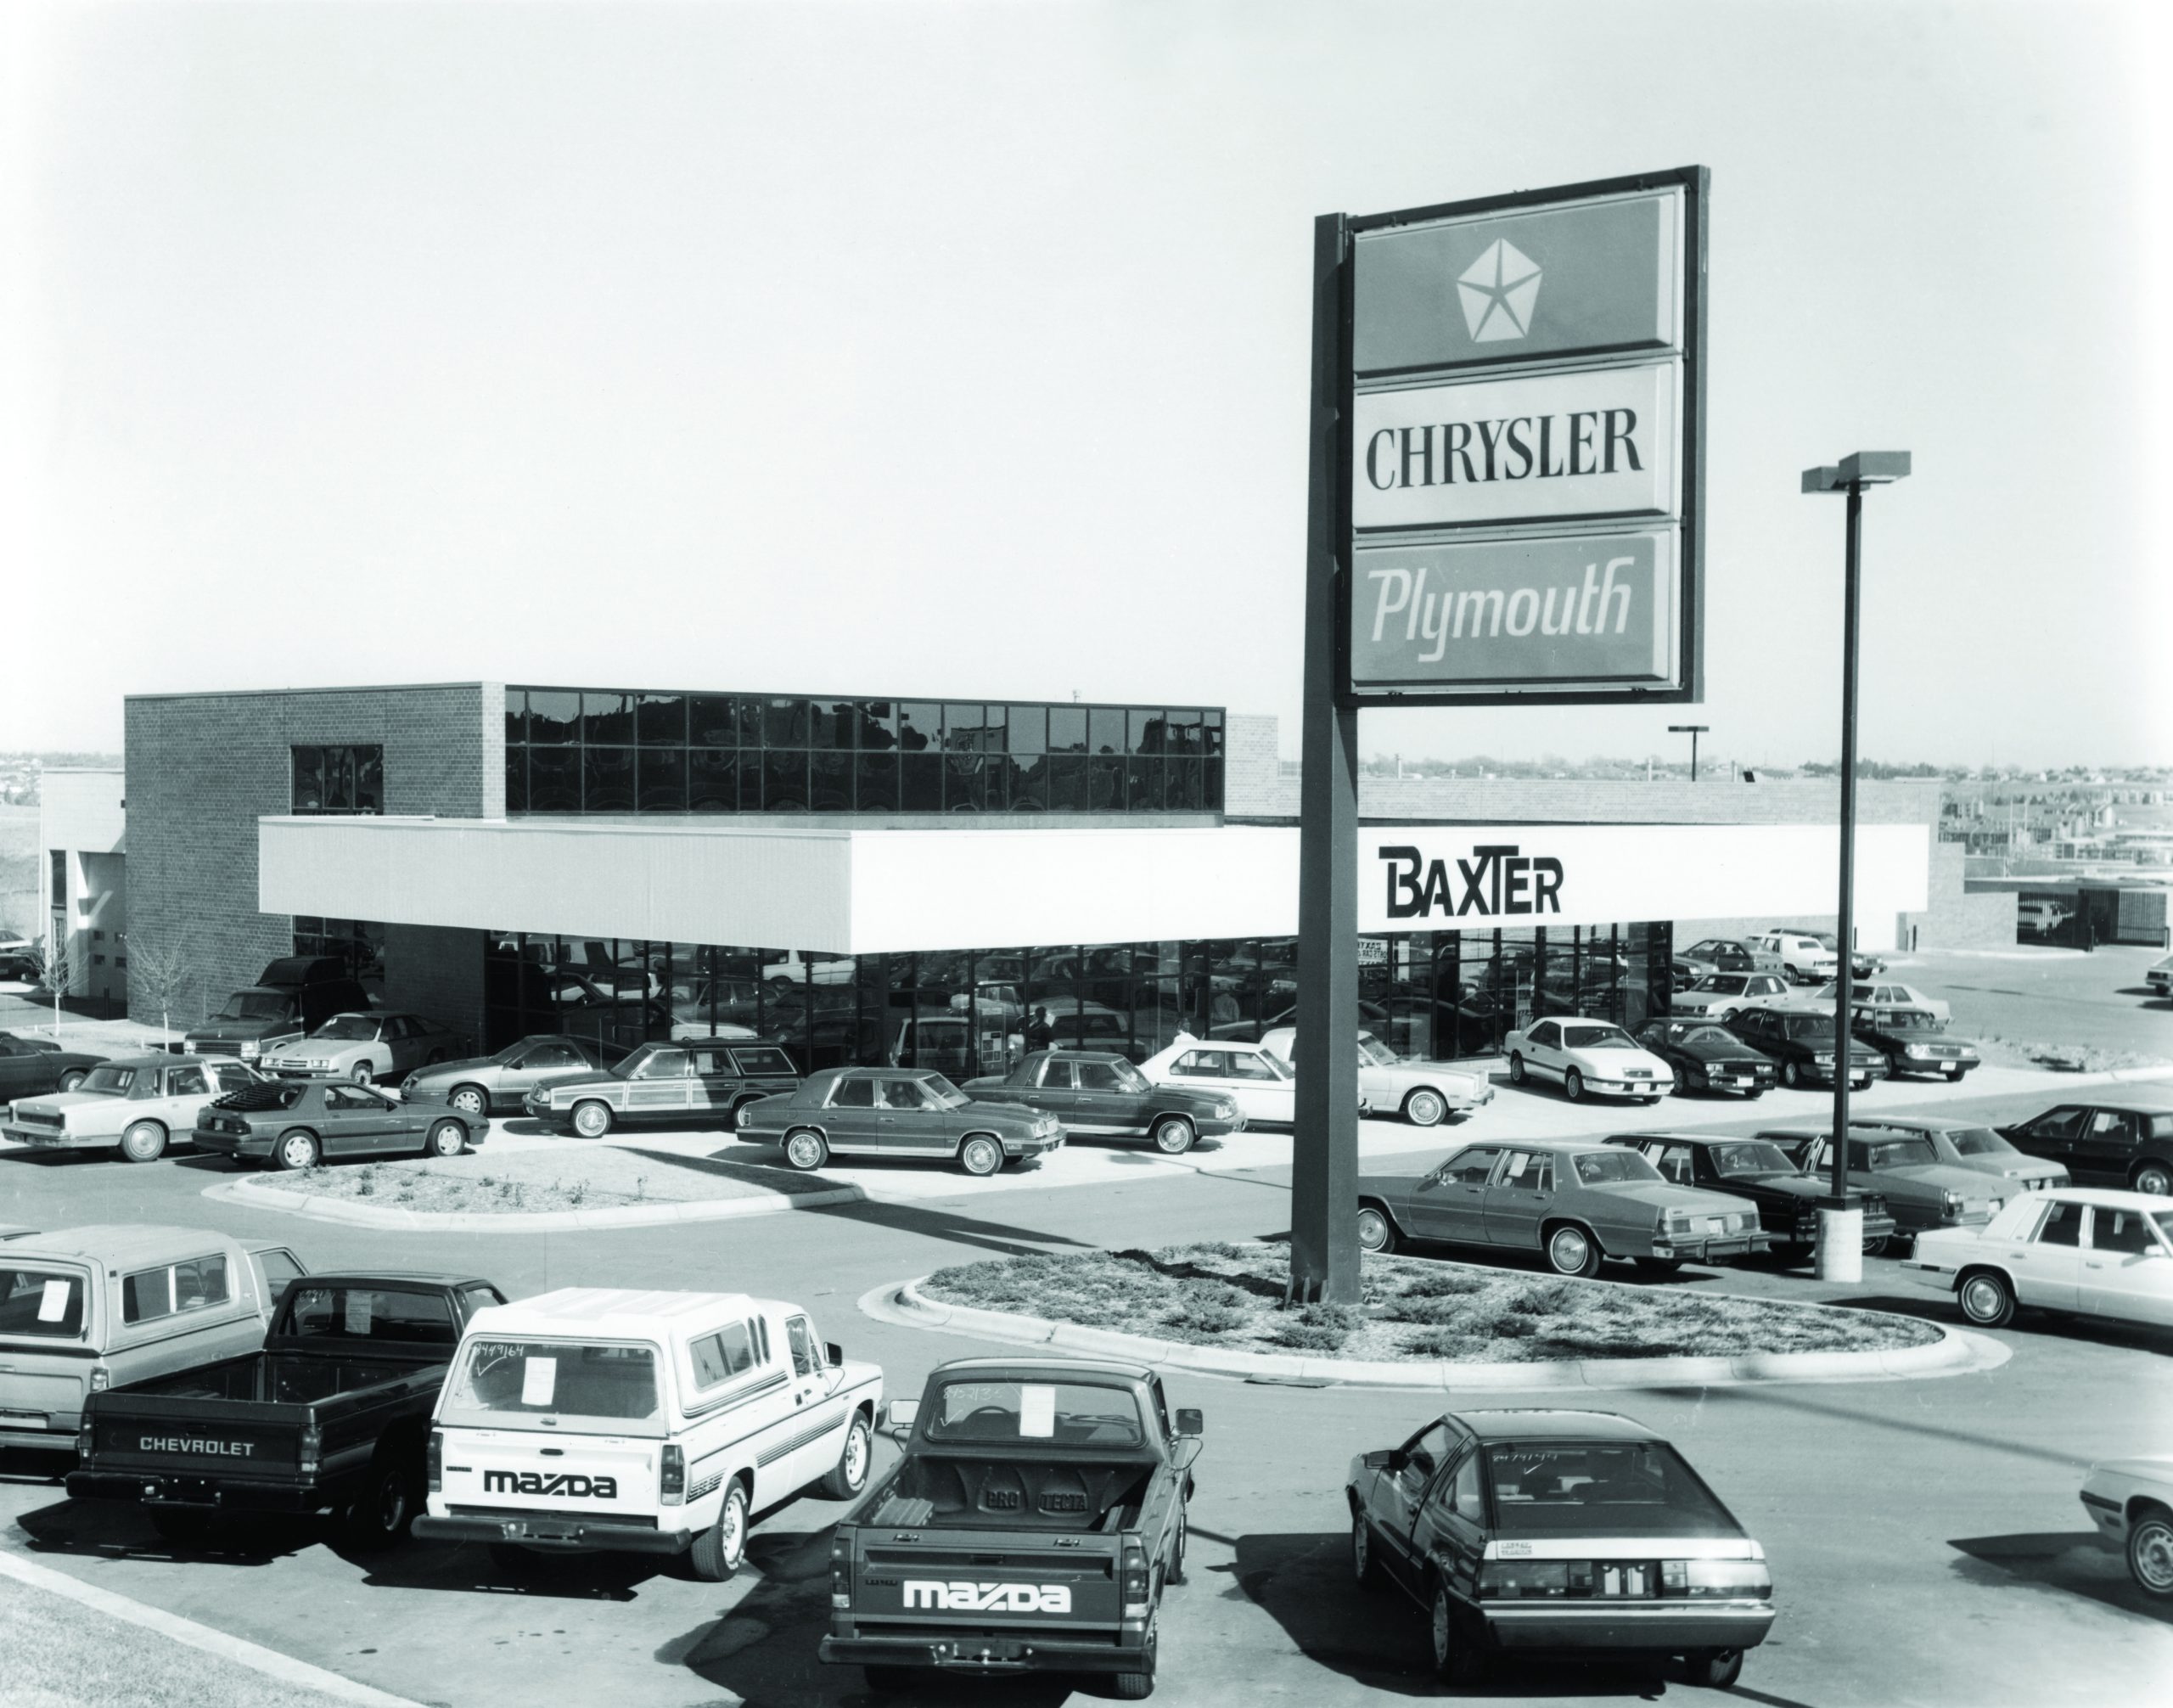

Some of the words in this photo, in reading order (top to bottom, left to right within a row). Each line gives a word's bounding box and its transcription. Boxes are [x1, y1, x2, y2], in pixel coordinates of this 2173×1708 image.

[1366, 408, 1645, 491] CHRYSLER
[1367, 556, 1635, 662] Plymouth
[1378, 845, 1564, 919] BAXTER
[140, 1437, 254, 1456] CHEVROLET
